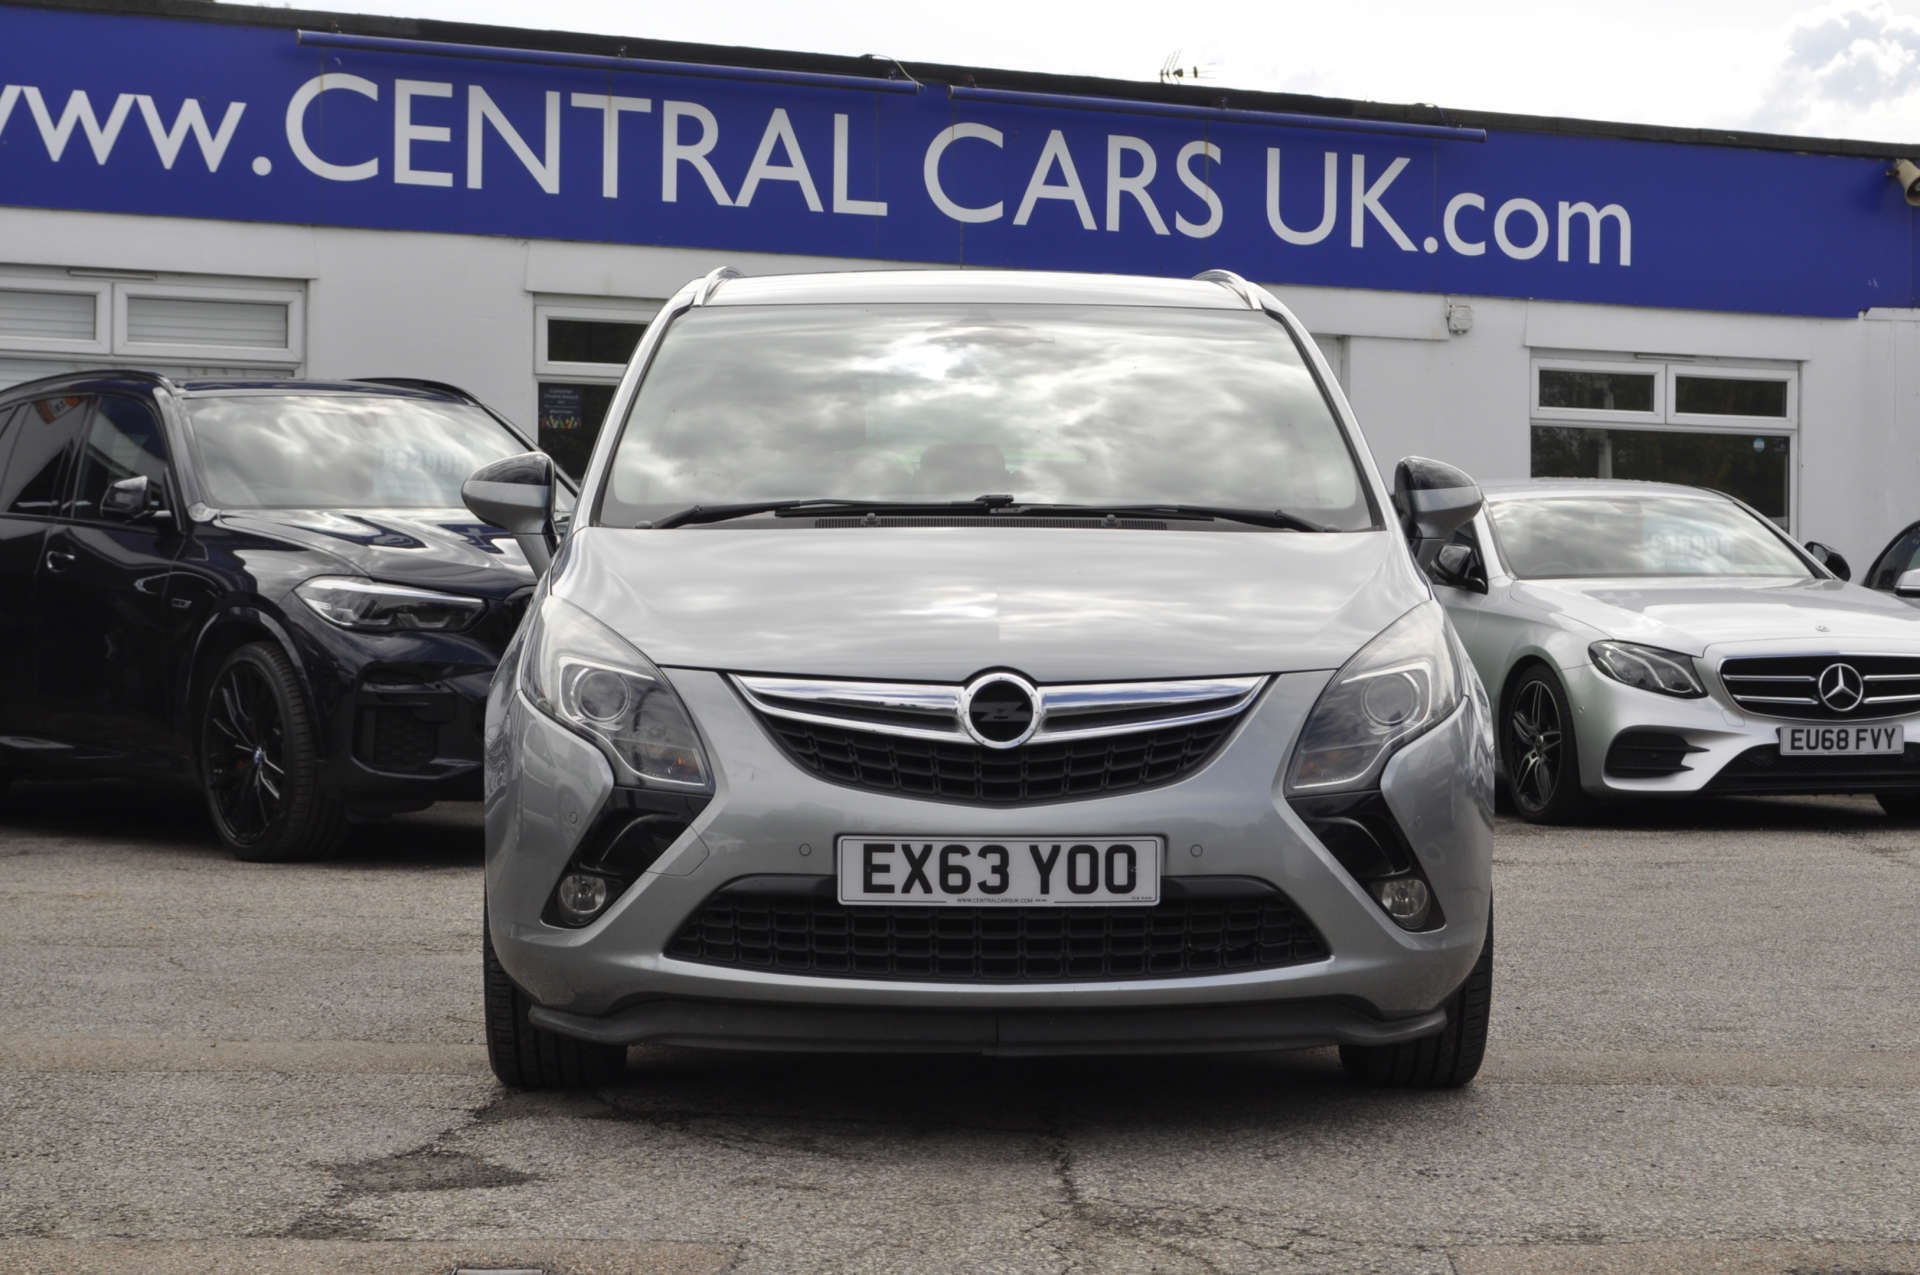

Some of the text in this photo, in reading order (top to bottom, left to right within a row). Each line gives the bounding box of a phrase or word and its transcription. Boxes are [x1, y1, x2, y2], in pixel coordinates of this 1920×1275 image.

[923, 122, 1224, 239] CARS
[1265, 147, 1632, 267] UK.com
[1790, 728, 1896, 750] EU68 FVY
[862, 843, 1137, 895] EX63 YOO
